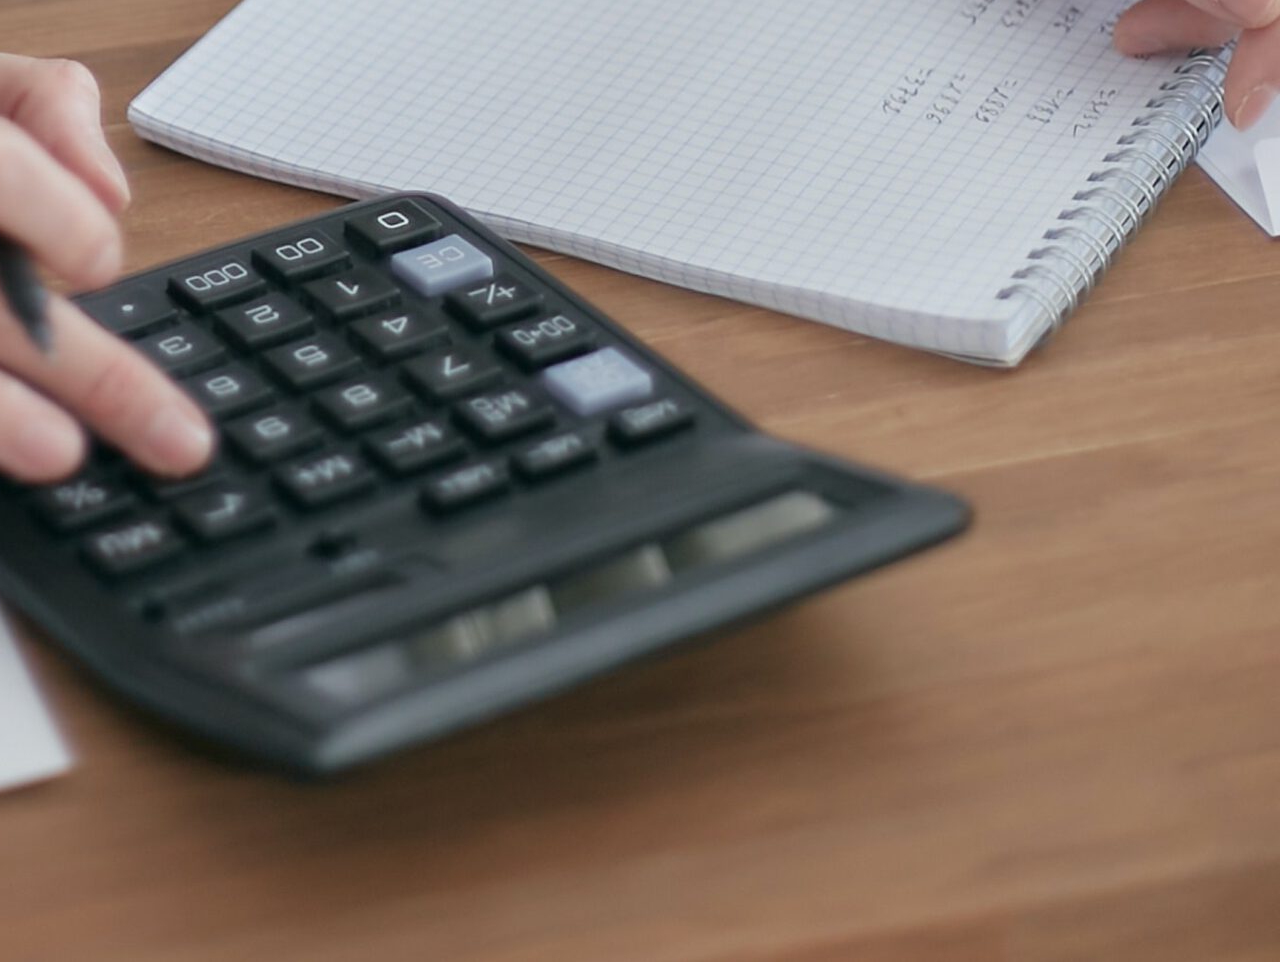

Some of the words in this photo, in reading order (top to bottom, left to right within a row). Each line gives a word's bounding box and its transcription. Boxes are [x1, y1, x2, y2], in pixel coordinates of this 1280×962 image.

[376, 212, 409, 229] 0
[275, 237, 325, 261] 00
[416, 245, 465, 270] CE
[184, 262, 248, 292] 000
[335, 280, 360, 297] 1
[244, 303, 280, 325] 2
[381, 315, 409, 335] 4
[158, 335, 193, 356] 3
[293, 344, 328, 366] 5
[442, 354, 470, 378] 7
[205, 375, 240, 397] 6
[341, 383, 378, 407] 8
[254, 416, 289, 439] 9
